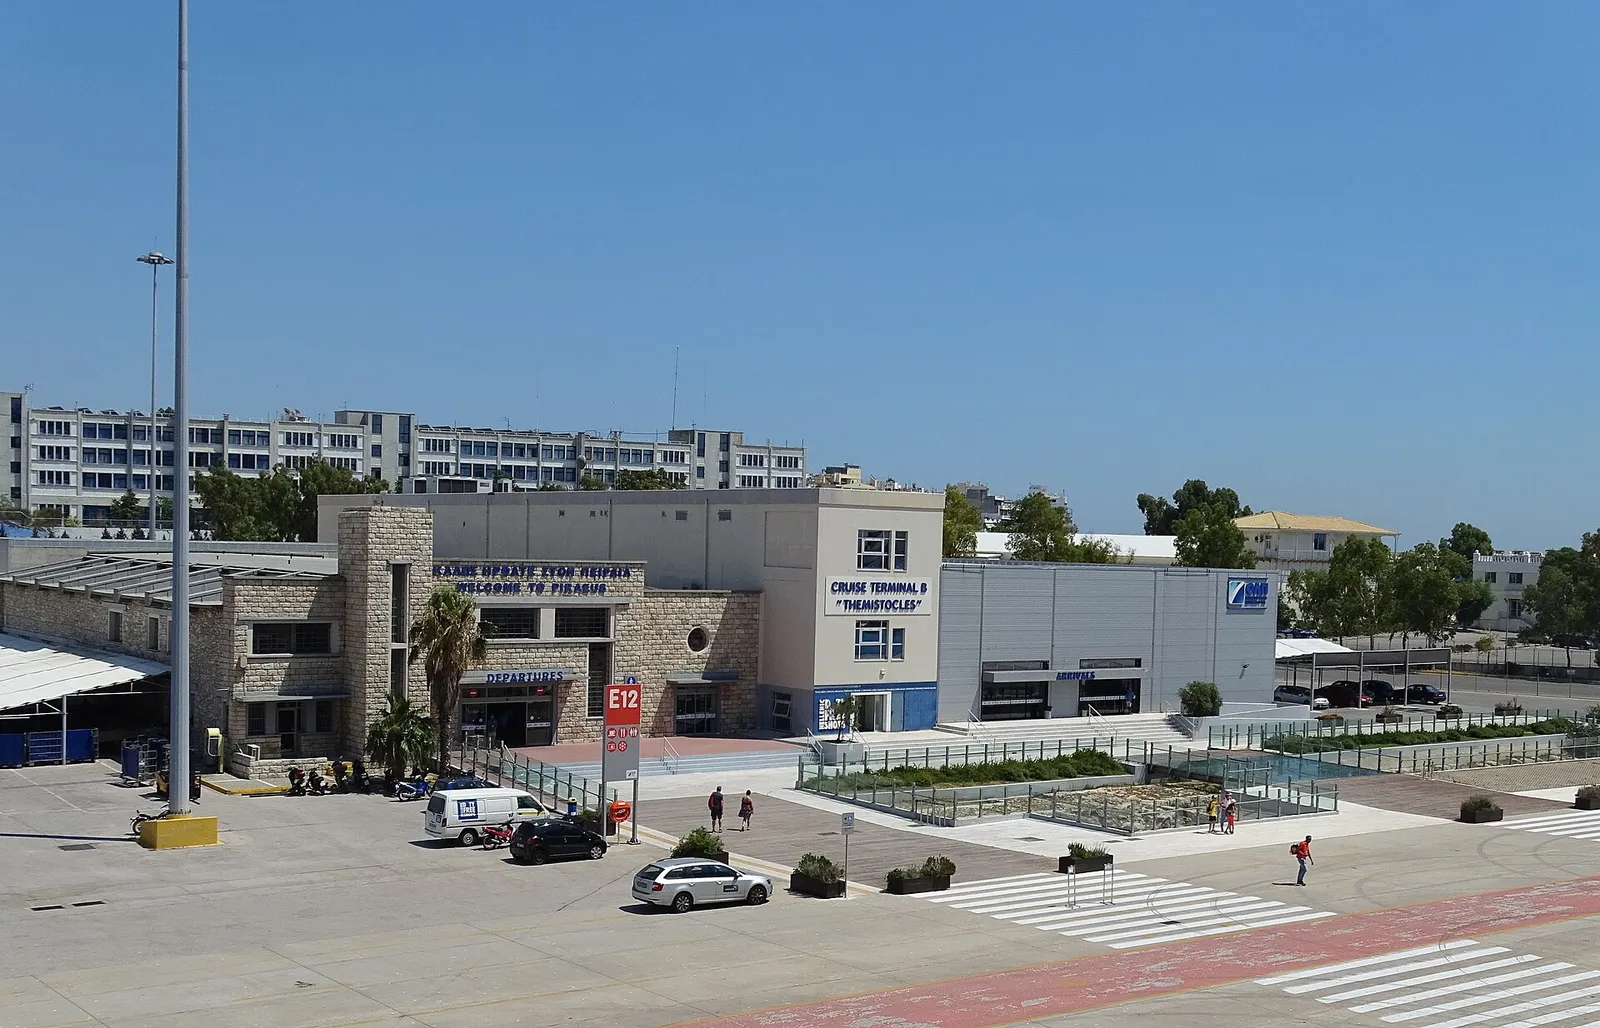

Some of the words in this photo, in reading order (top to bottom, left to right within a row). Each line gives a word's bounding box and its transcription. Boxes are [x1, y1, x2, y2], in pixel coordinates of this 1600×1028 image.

[456, 582, 521, 593] WELCOME
[528, 582, 545, 594] TO
[551, 583, 607, 594] PIRAEUS
[831, 581, 867, 593] CRUISE
[870, 582, 919, 593] TERMINAL
[920, 582, 928, 593] B
[486, 671, 564, 684] DEPARTURES
[1056, 671, 1096, 681] ARRIVALS
[609, 688, 638, 709] E12
